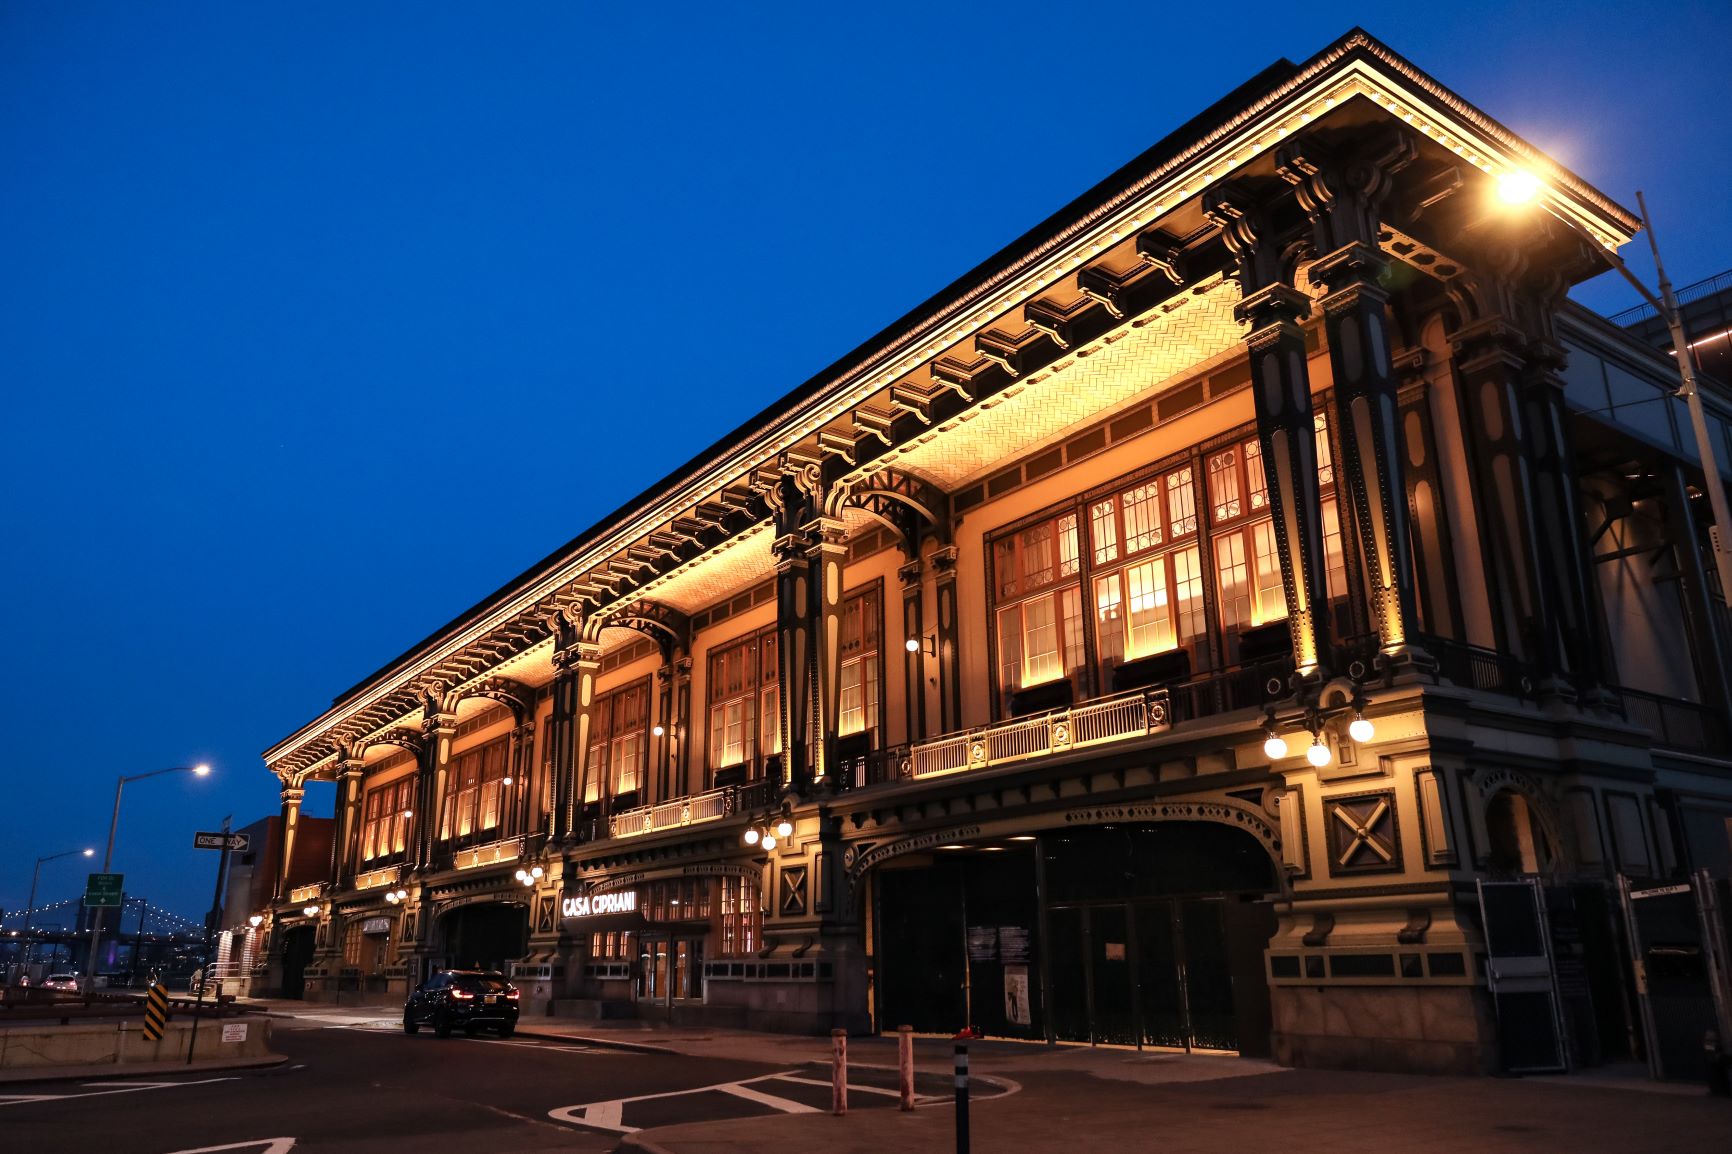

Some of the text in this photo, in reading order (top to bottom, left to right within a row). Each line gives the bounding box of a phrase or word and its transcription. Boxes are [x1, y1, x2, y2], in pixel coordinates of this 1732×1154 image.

[199, 837, 216, 846] ONE
[563, 892, 636, 917] CASA CIPRIANI
